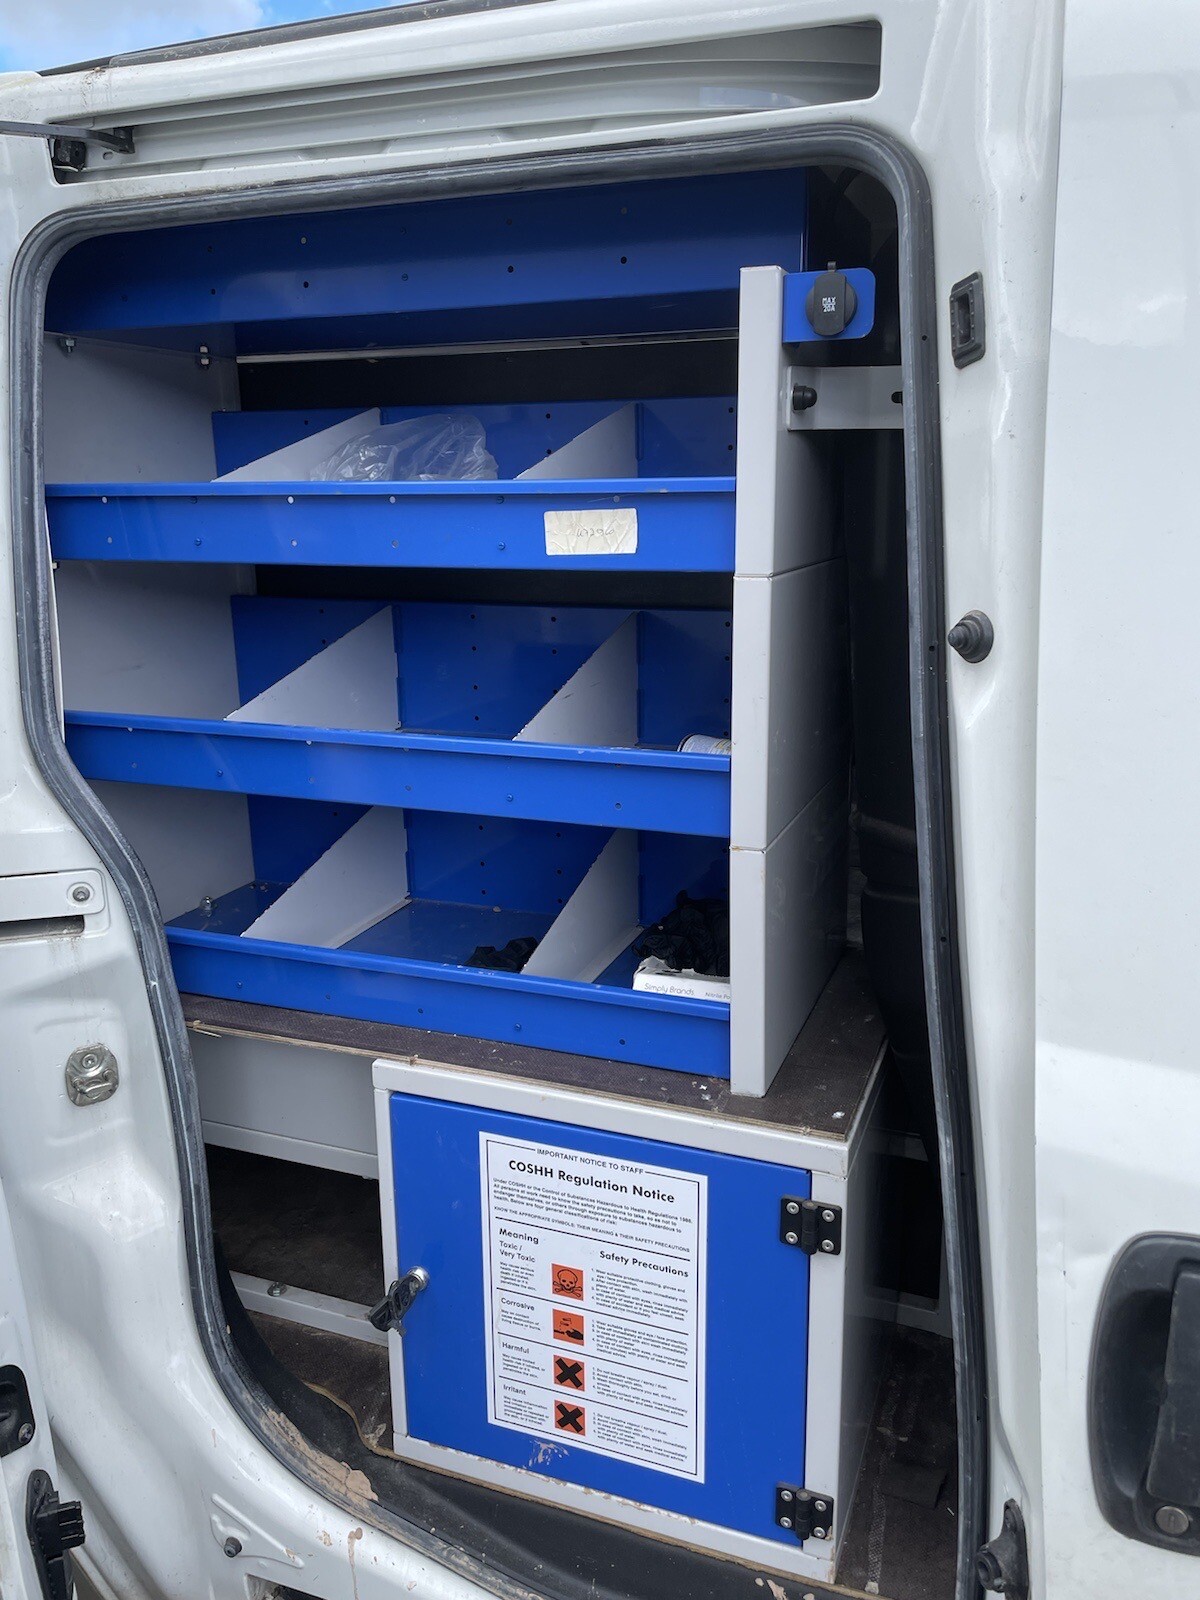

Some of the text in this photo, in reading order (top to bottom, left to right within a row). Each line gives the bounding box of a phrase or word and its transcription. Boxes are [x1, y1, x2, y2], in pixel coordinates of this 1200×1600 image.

[823, 304, 836, 312] 20A
[644, 982, 669, 993] Simply
[670, 986, 695, 996] Brands
[537, 1148, 643, 1175] IMPORTANT NOTICE TO STAFF
[509, 1159, 674, 1203] COSHH Regulation Notice
[499, 1227, 539, 1245] Meaning
[500, 1240, 522, 1252] Toxic /
[500, 1249, 536, 1263] Very Toxic
[600, 1250, 688, 1278] Safety Precautions
[501, 1297, 535, 1311] Corrosive
[502, 1342, 529, 1354] Harmful
[503, 1384, 526, 1396] Irritant
